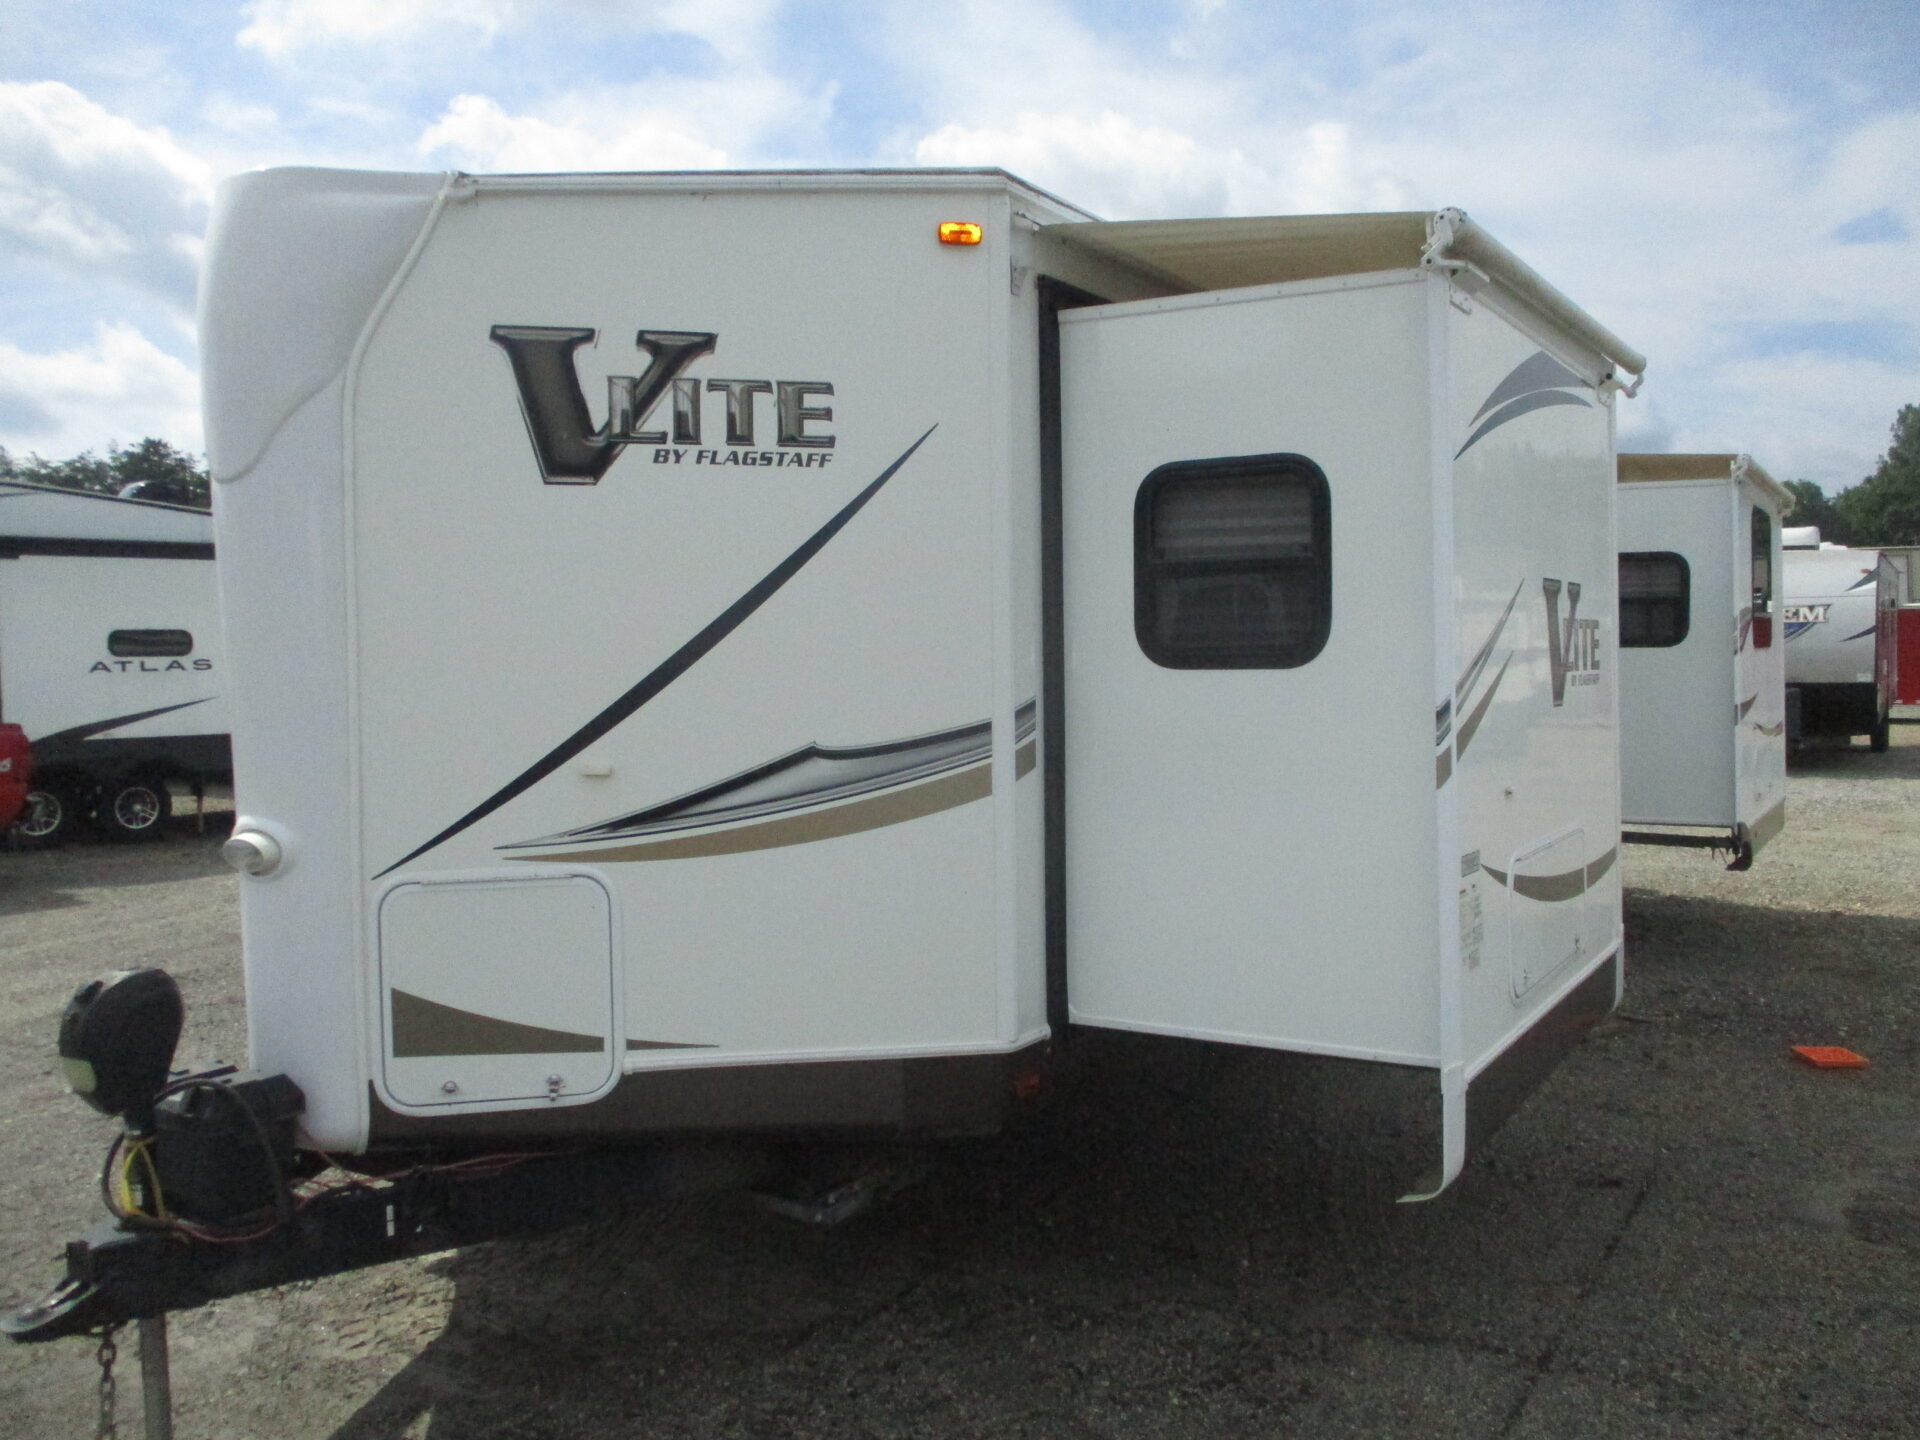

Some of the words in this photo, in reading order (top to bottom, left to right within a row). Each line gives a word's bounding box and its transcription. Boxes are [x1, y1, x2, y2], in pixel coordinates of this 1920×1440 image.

[653, 448, 685, 465] BY
[696, 449, 833, 468] FLAGSTAFF
[88, 658, 213, 674] ATLAS
